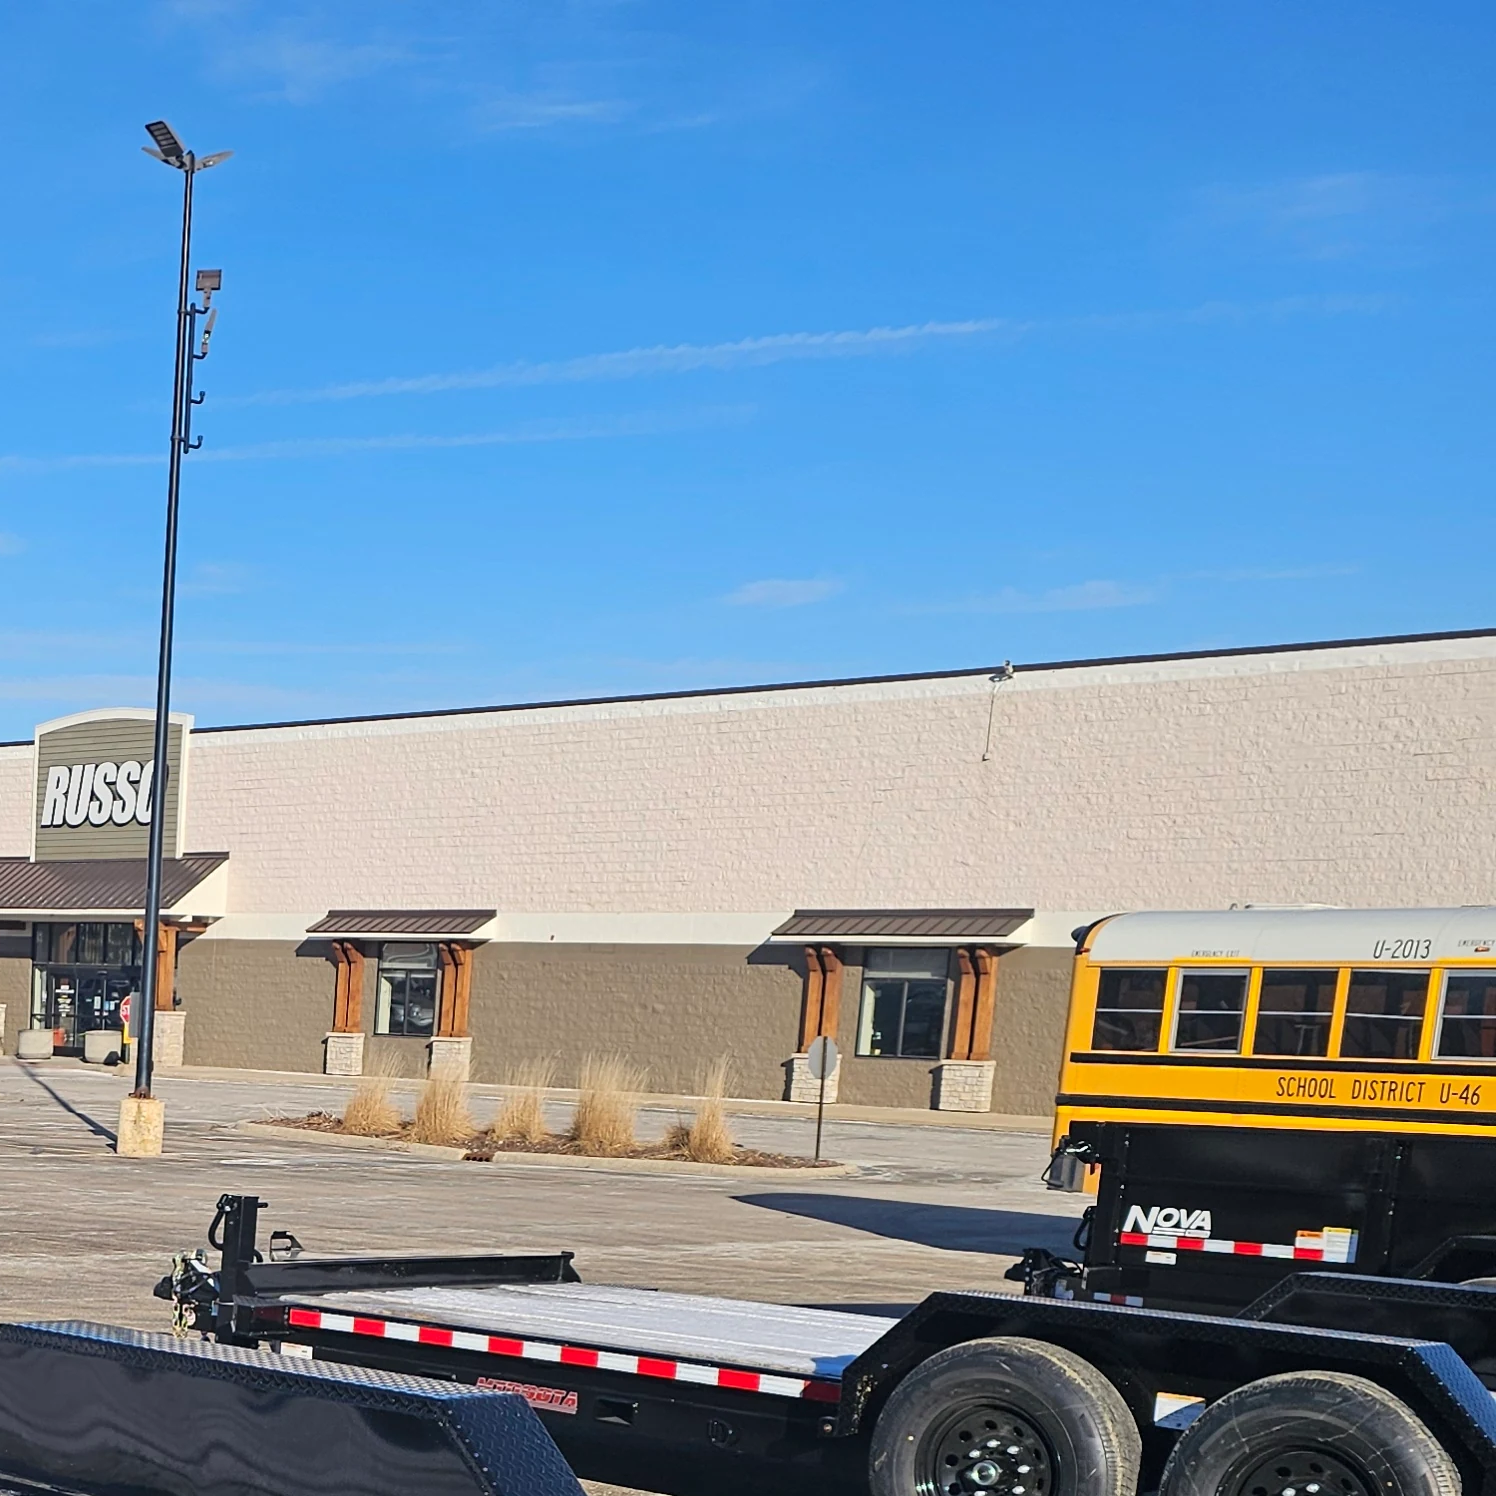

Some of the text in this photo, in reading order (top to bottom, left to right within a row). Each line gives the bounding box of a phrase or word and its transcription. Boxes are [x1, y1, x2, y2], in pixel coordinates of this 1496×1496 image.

[1373, 938, 1432, 960] U-2013
[1276, 1076, 1482, 1106] SCHOOL DISTRICT U-46
[1122, 1205, 1212, 1234] NOVA
